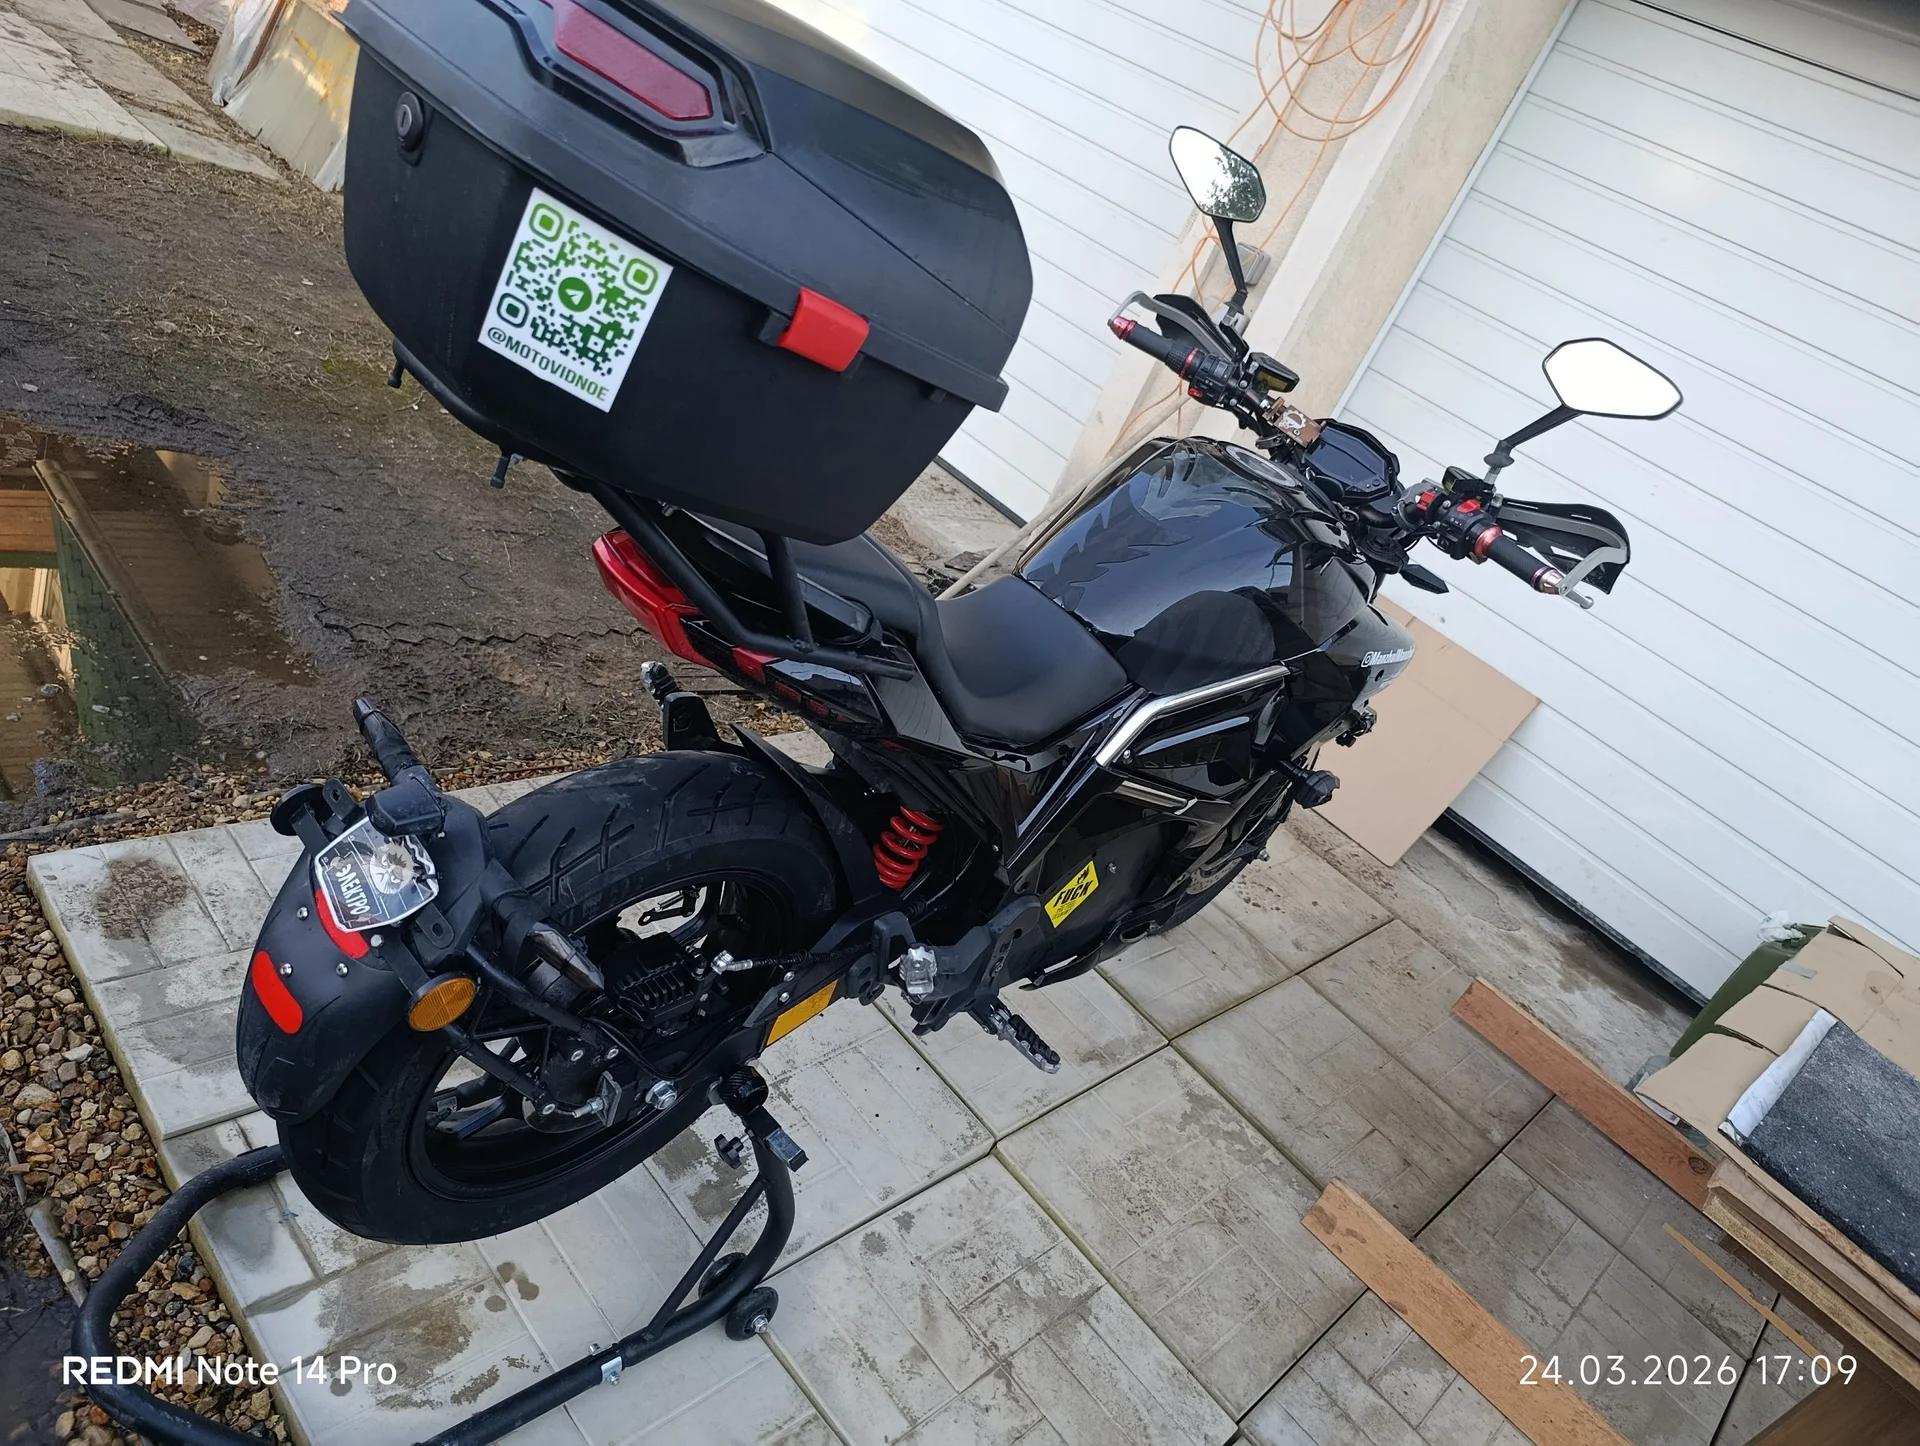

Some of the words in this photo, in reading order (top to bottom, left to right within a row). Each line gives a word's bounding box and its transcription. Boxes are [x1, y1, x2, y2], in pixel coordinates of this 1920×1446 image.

[487, 326, 610, 402] @MOTOVIDNOE
[335, 863, 371, 915] ЭЛЕКТРО
[1053, 880, 1094, 908] FUCK
